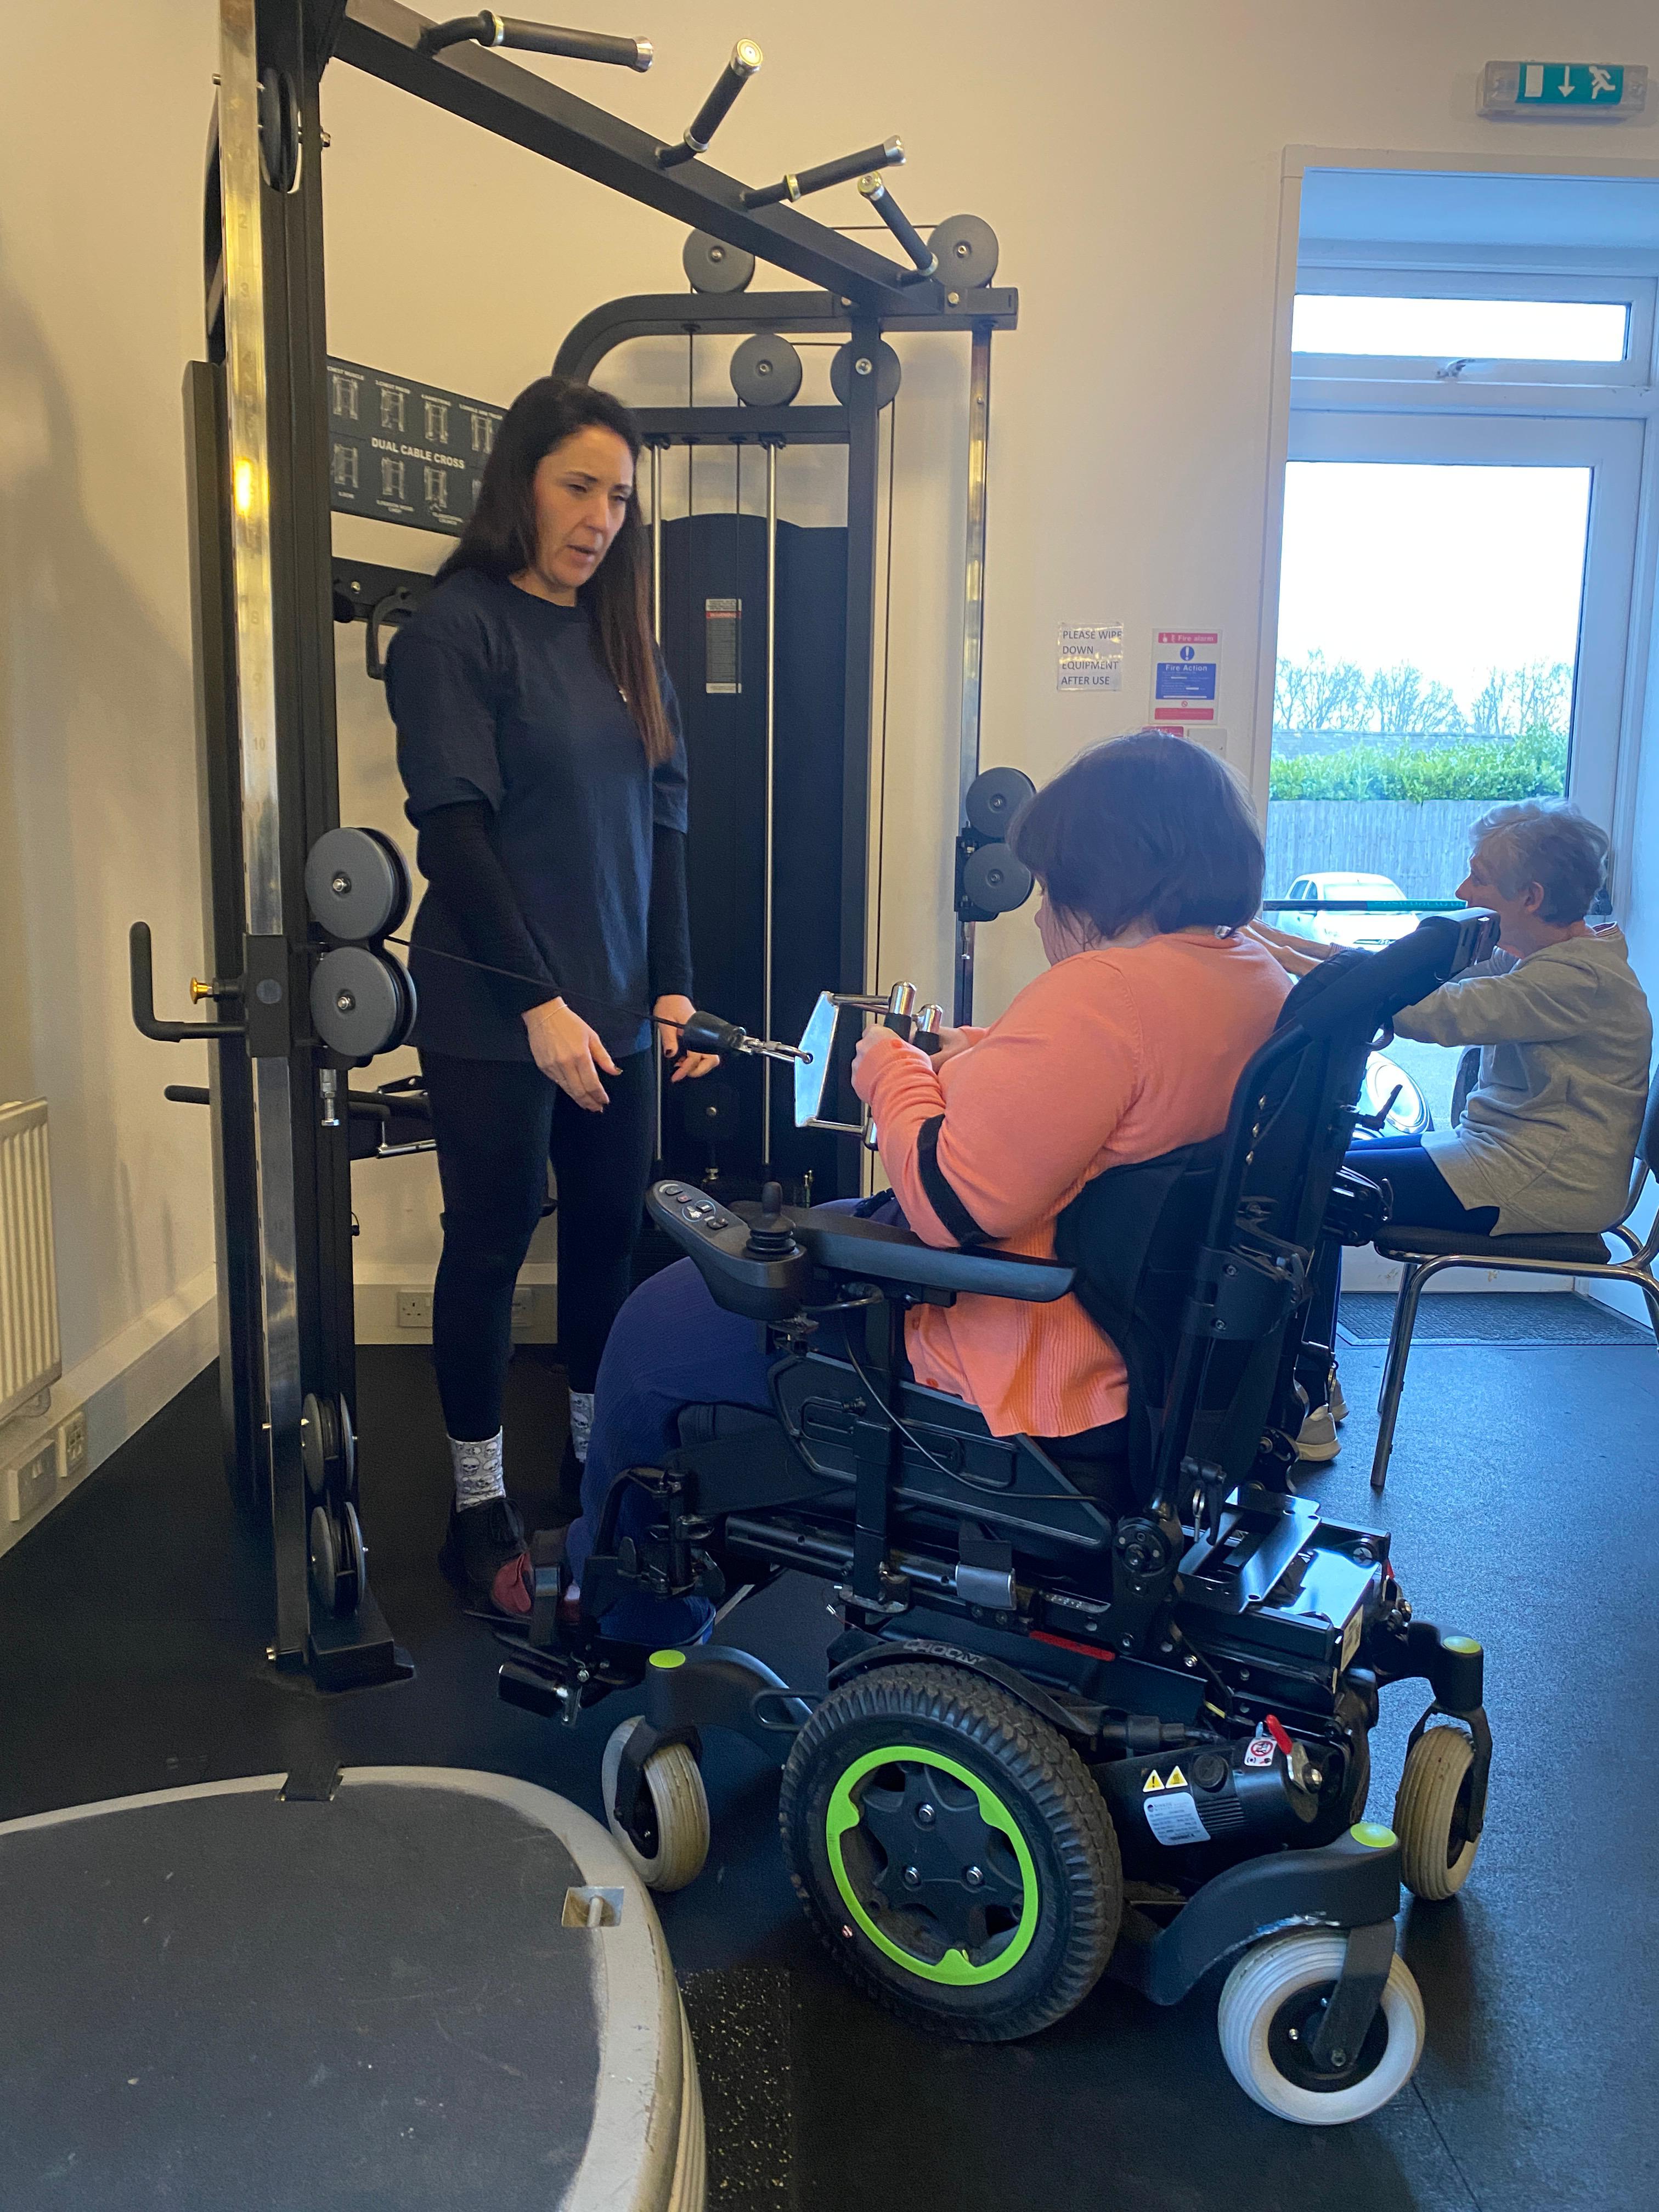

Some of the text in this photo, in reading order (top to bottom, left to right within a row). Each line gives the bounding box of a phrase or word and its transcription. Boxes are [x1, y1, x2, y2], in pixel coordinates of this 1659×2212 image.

[371, 437, 465, 469] DUAL CABLE CROSS
[1063, 630, 1095, 639] PLEASE
[1063, 646, 1093, 654] DOWN
[1062, 661, 1119, 670] EQUIPMENT
[1061, 676, 1110, 685] AFTER USE
